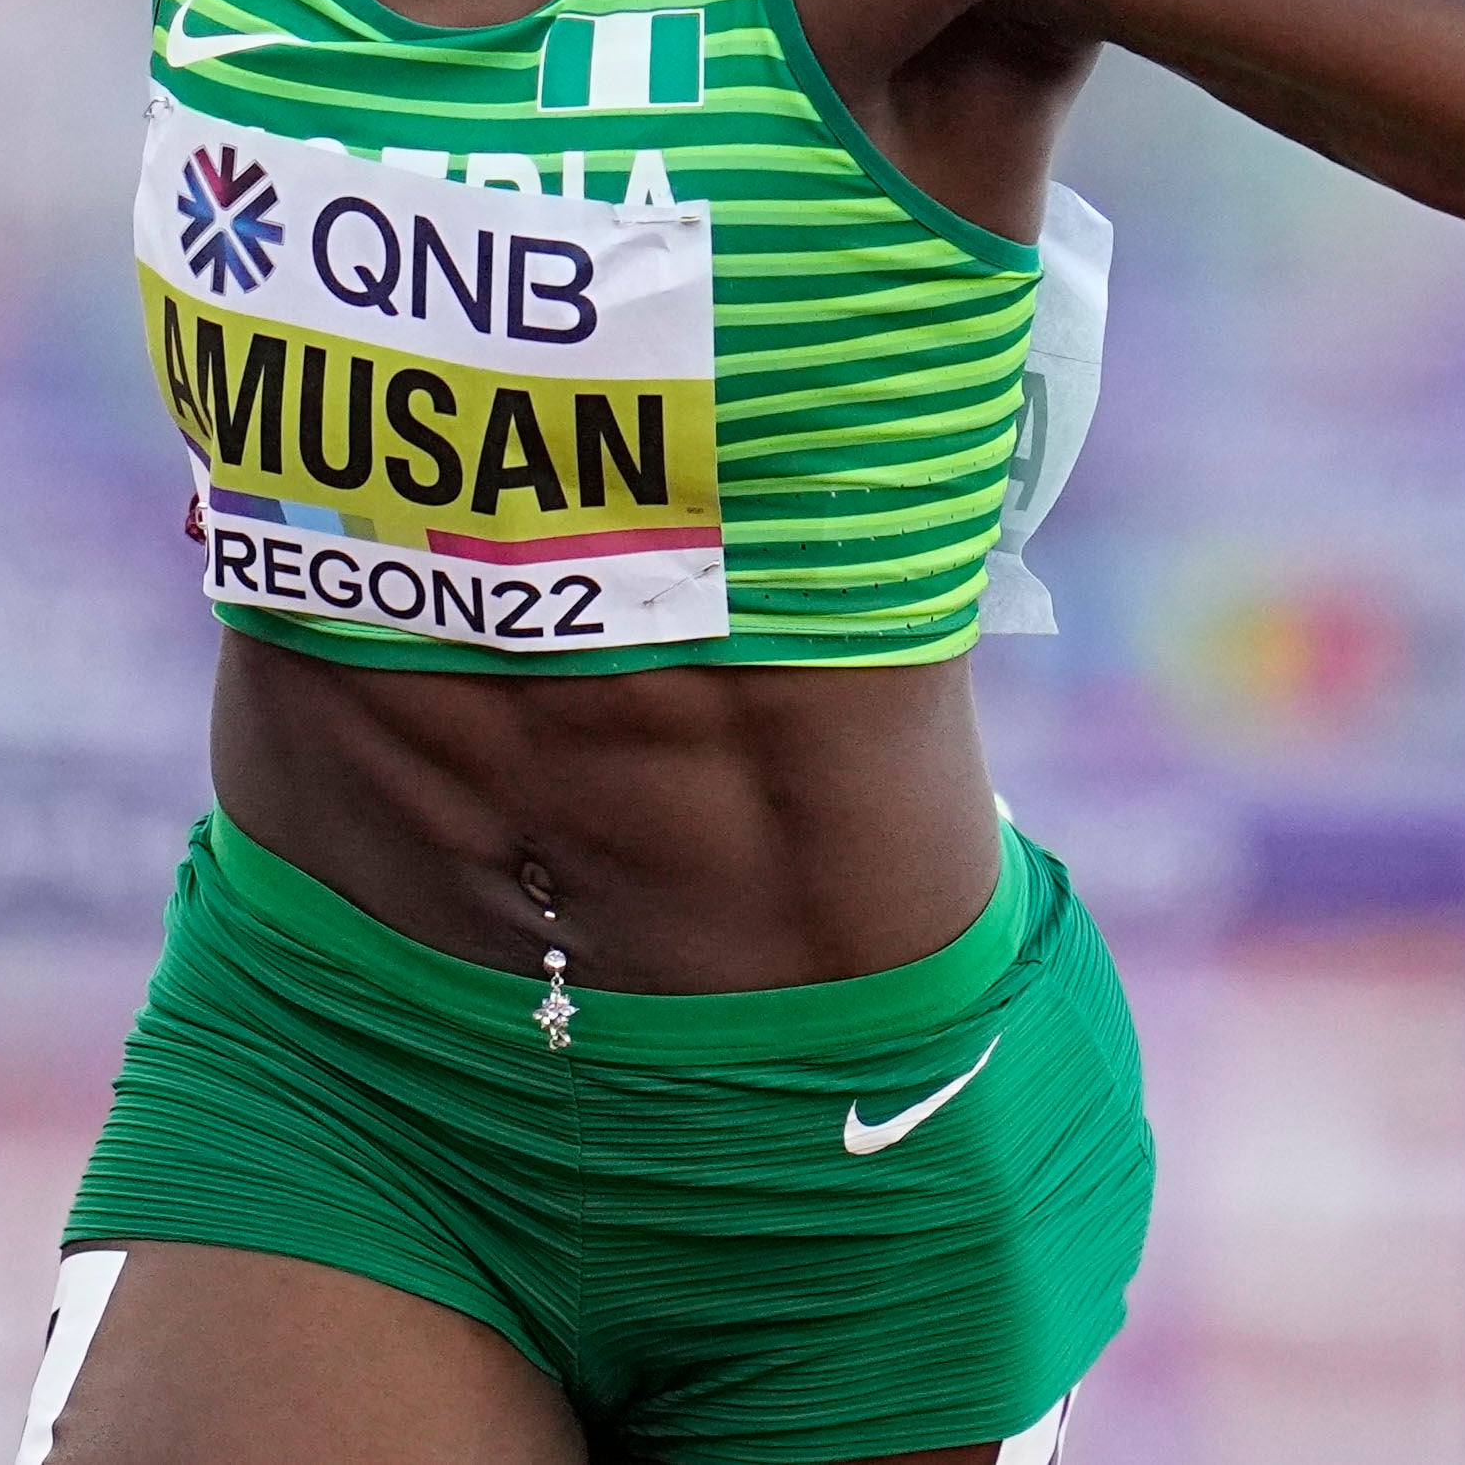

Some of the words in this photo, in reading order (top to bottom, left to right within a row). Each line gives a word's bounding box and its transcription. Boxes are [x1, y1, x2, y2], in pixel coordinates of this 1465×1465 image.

[311, 195, 598, 344] QNB
[164, 295, 669, 516] AMUSAN
[203, 528, 604, 639] REGON22
